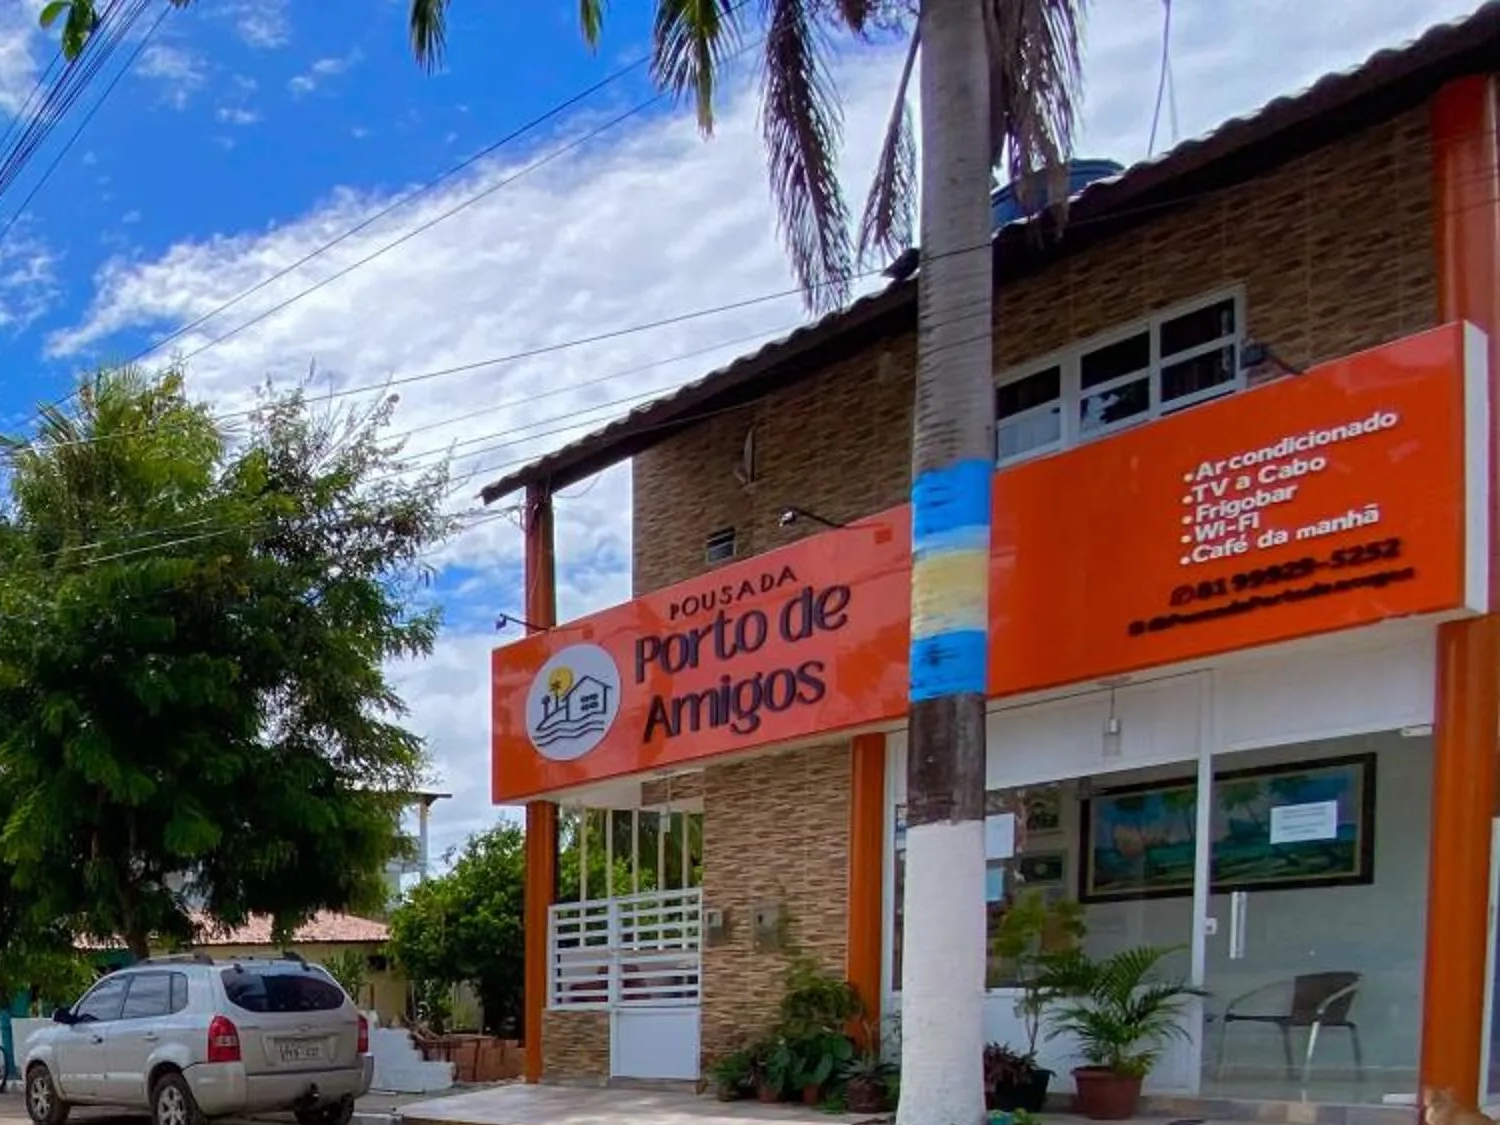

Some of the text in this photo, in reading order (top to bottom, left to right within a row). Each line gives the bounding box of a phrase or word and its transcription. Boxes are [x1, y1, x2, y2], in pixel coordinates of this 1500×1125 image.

[1192, 456, 1327, 502] TV a Cabo
[1196, 484, 1297, 523] Frigobar
[1192, 503, 1380, 563] Café da manhã
[670, 566, 797, 620] POUSADA
[635, 585, 850, 684] Porto de
[643, 660, 826, 743] Amigos
